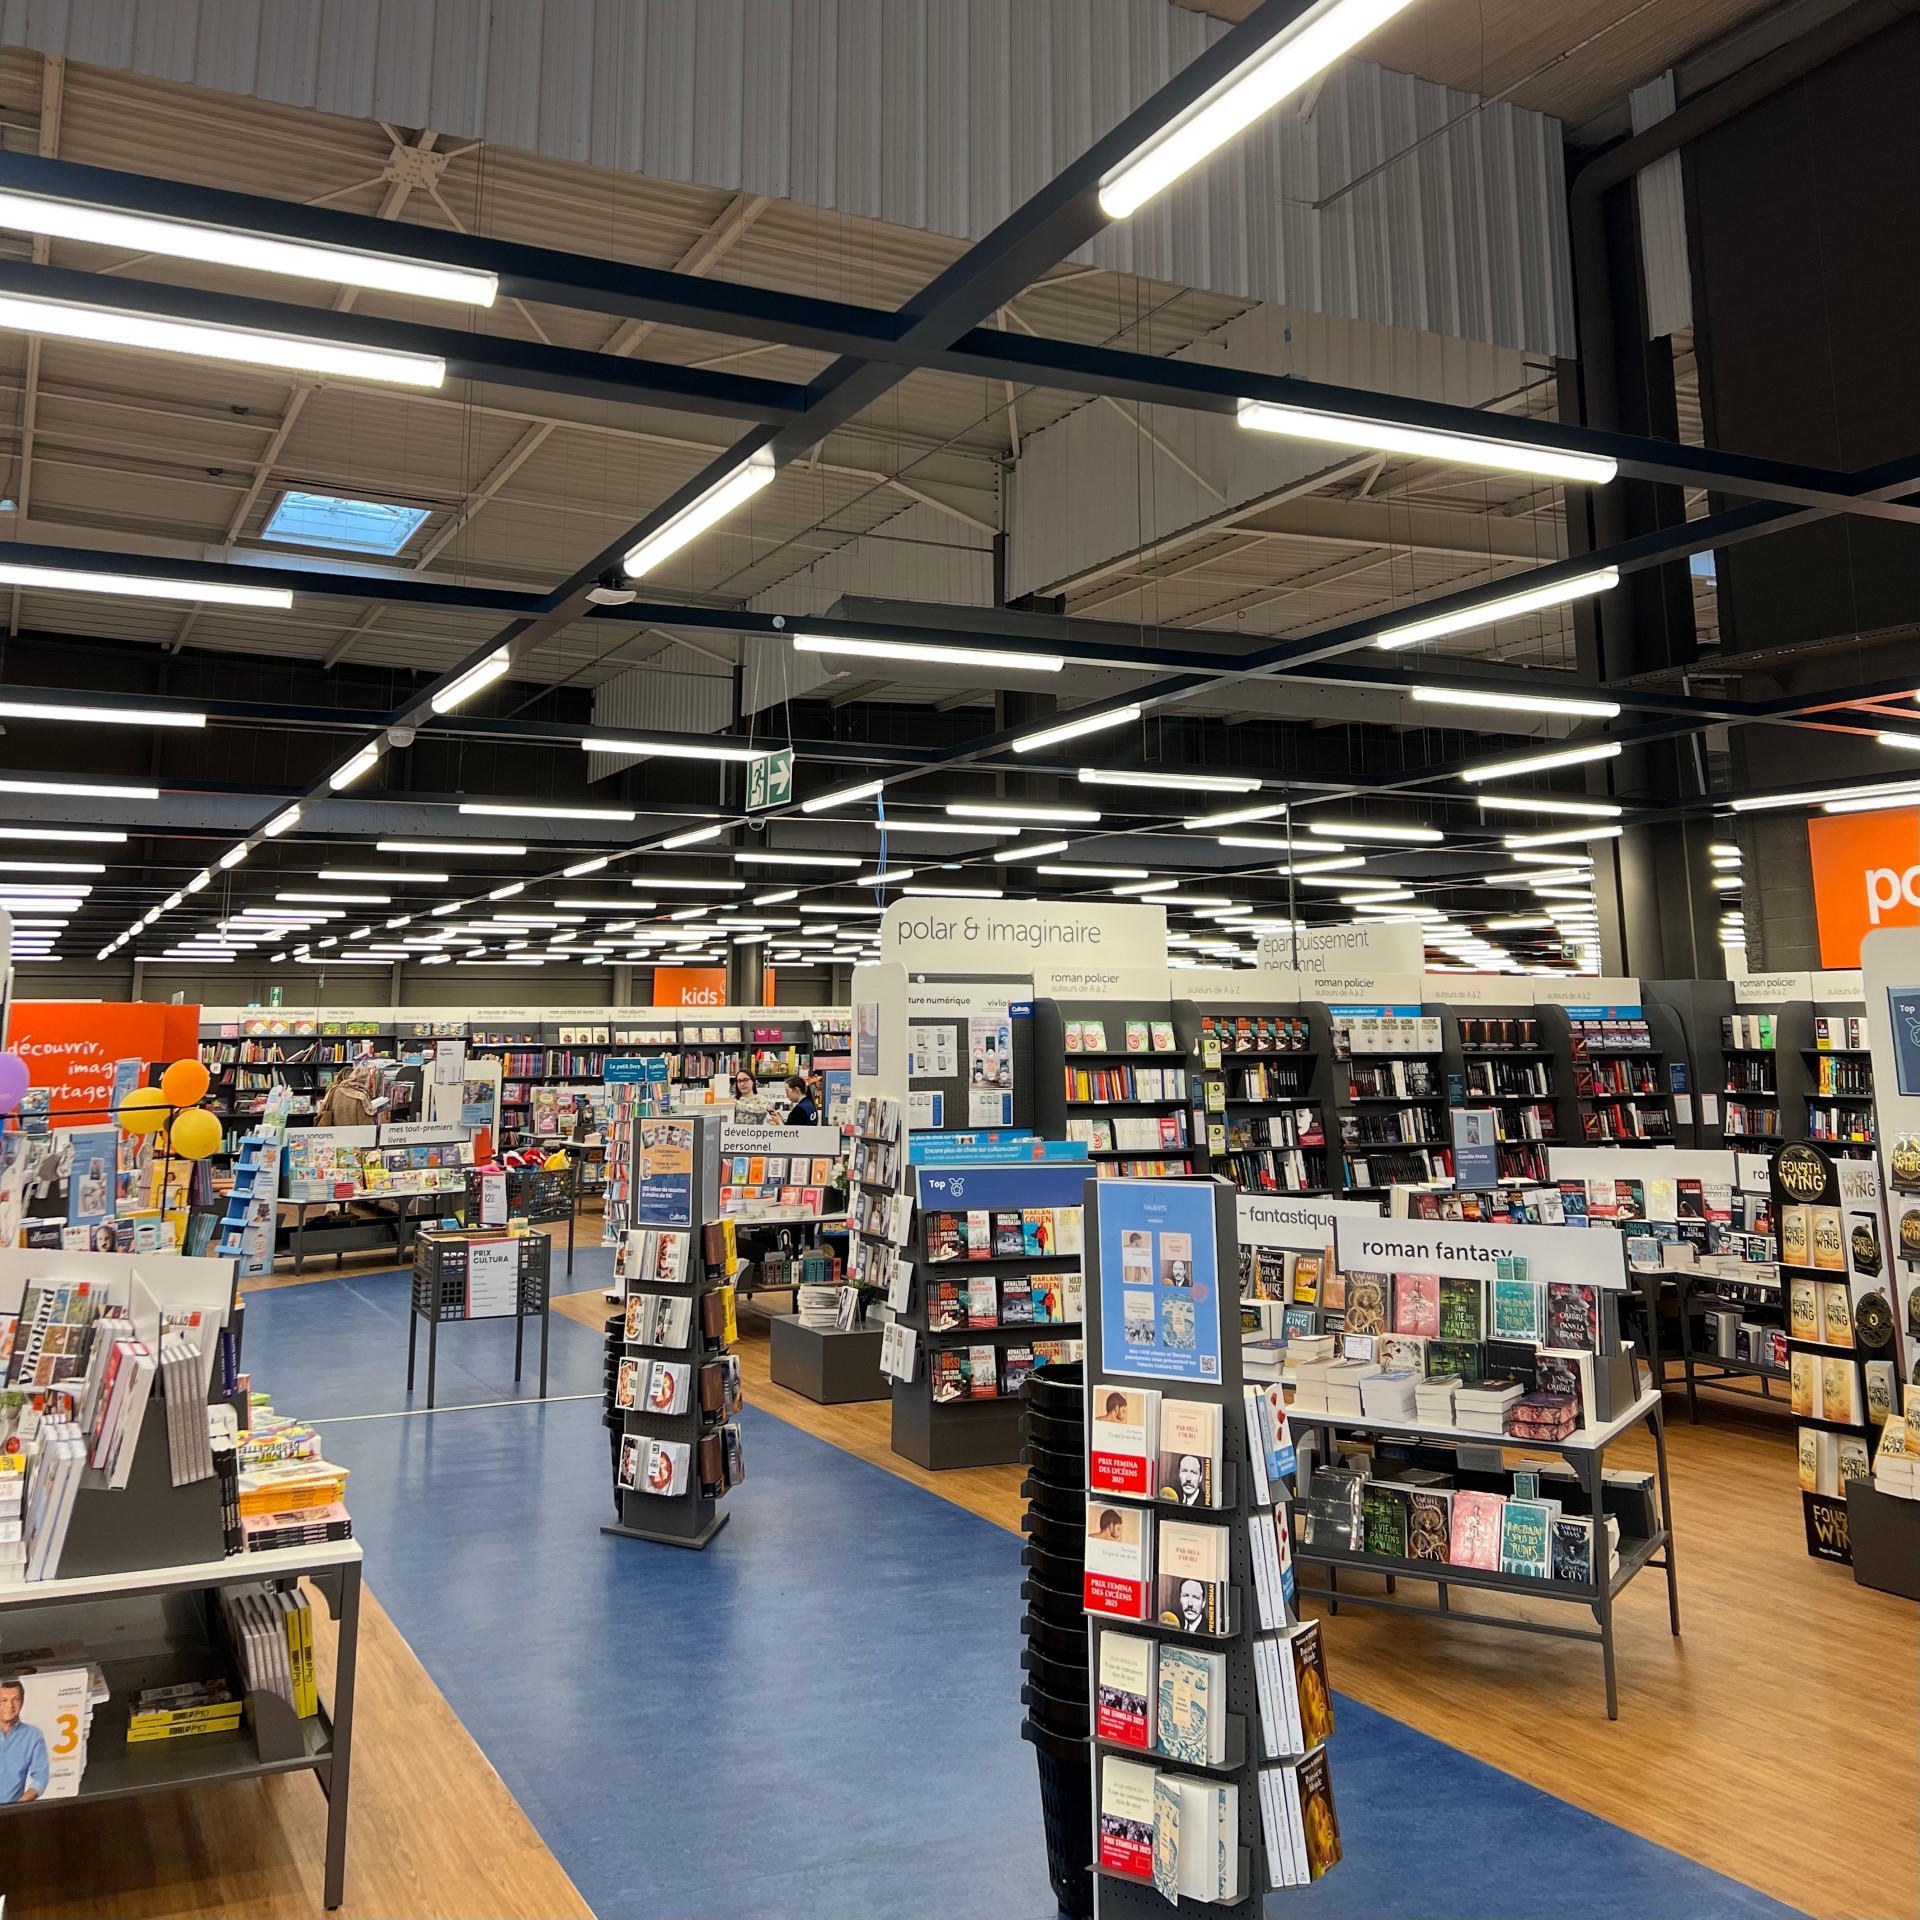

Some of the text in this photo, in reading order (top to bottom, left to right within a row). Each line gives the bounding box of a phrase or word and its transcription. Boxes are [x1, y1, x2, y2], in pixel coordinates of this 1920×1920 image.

[898, 916, 1101, 947] polar & imaginaire
[1051, 973, 1119, 985] roman policier
[1315, 978, 1375, 989] roman policier
[1740, 978, 1796, 988] roman policier
[1051, 985, 1087, 993] auteurs de
[1188, 987, 1223, 995] auteurs de
[1315, 989, 1347, 997] auteurs de
[1435, 991, 1467, 999] auteurs de
[1740, 989, 1769, 997] auteurs de
[681, 987, 718, 1005] kids
[926, 996, 971, 1009] numérique
[1899, 1004, 1916, 1015] Top
[7, 1034, 105, 1056] découvrir,
[68, 1060, 151, 1080] imagr
[405, 1124, 453, 1134] tout-premiers
[724, 1127, 800, 1140] développement
[306, 1131, 334, 1140] sonores
[387, 1136, 407, 1144] livres
[723, 1142, 772, 1153] personnel
[943, 1147, 955, 1155] plus
[1781, 1160, 1822, 1175] FOURTH
[1782, 1172, 1824, 1191] WING
[1842, 1170, 1874, 1184] FOURTH
[929, 1180, 946, 1190] Top
[1843, 1182, 1876, 1198] WING
[1144, 1204, 1167, 1212] TALENTS
[940, 1219, 957, 1231] BUSSI
[1024, 1215, 1051, 1224] COBEN
[1250, 1206, 1336, 1234] fantastique
[1785, 1225, 1805, 1238] FOURTH
[1815, 1229, 1838, 1241] FOURTH
[1785, 1234, 1805, 1246] WING
[1815, 1237, 1840, 1250] WING
[1363, 1241, 1429, 1259] roman
[1853, 1244, 1874, 1258] WING
[473, 1255, 509, 1265] CULTURA
[1298, 1262, 1317, 1272] KING
[1032, 1281, 1060, 1290] COBEN
[940, 1288, 958, 1300] BUSSI
[1454, 1305, 1467, 1313] DANS
[1793, 1299, 1814, 1310] FOURTH
[1827, 1304, 1846, 1317] FOURTH
[1287, 1311, 1308, 1319] STEPHEN
[1454, 1312, 1465, 1321] VIE
[1794, 1308, 1815, 1321] WING
[1828, 1313, 1848, 1327] WING
[1286, 1316, 1307, 1327] KING
[1445, 1320, 1476, 1330] PANTINS
[18, 1288, 56, 1385] Vinoland
[1034, 1348, 1060, 1358] COBEN
[1869, 1394, 1890, 1408] WING
[1097, 1457, 1139, 1470] PRIX FEMINA
[1840, 1455, 1866, 1470] FOURTH
[1098, 1465, 1138, 1478] DES LYCÉENS
[1841, 1466, 1867, 1478] WING
[1204, 1480, 1212, 1506] PREMIER
[1378, 1523, 1390, 1533] VIE
[1563, 1529, 1581, 1539] MAAS
[1369, 1531, 1400, 1545] PANTINS
[1511, 1543, 1538, 1558] RUINES
[1560, 1569, 1583, 1581] CITY
[1090, 1578, 1133, 1593] PRIX FEMINA
[1091, 1587, 1132, 1602] DES LYCÉENS
[1101, 1706, 1111, 1716] PRIX
[51, 1713, 79, 1754] 3
[1103, 1834, 1115, 1845] PRIX
